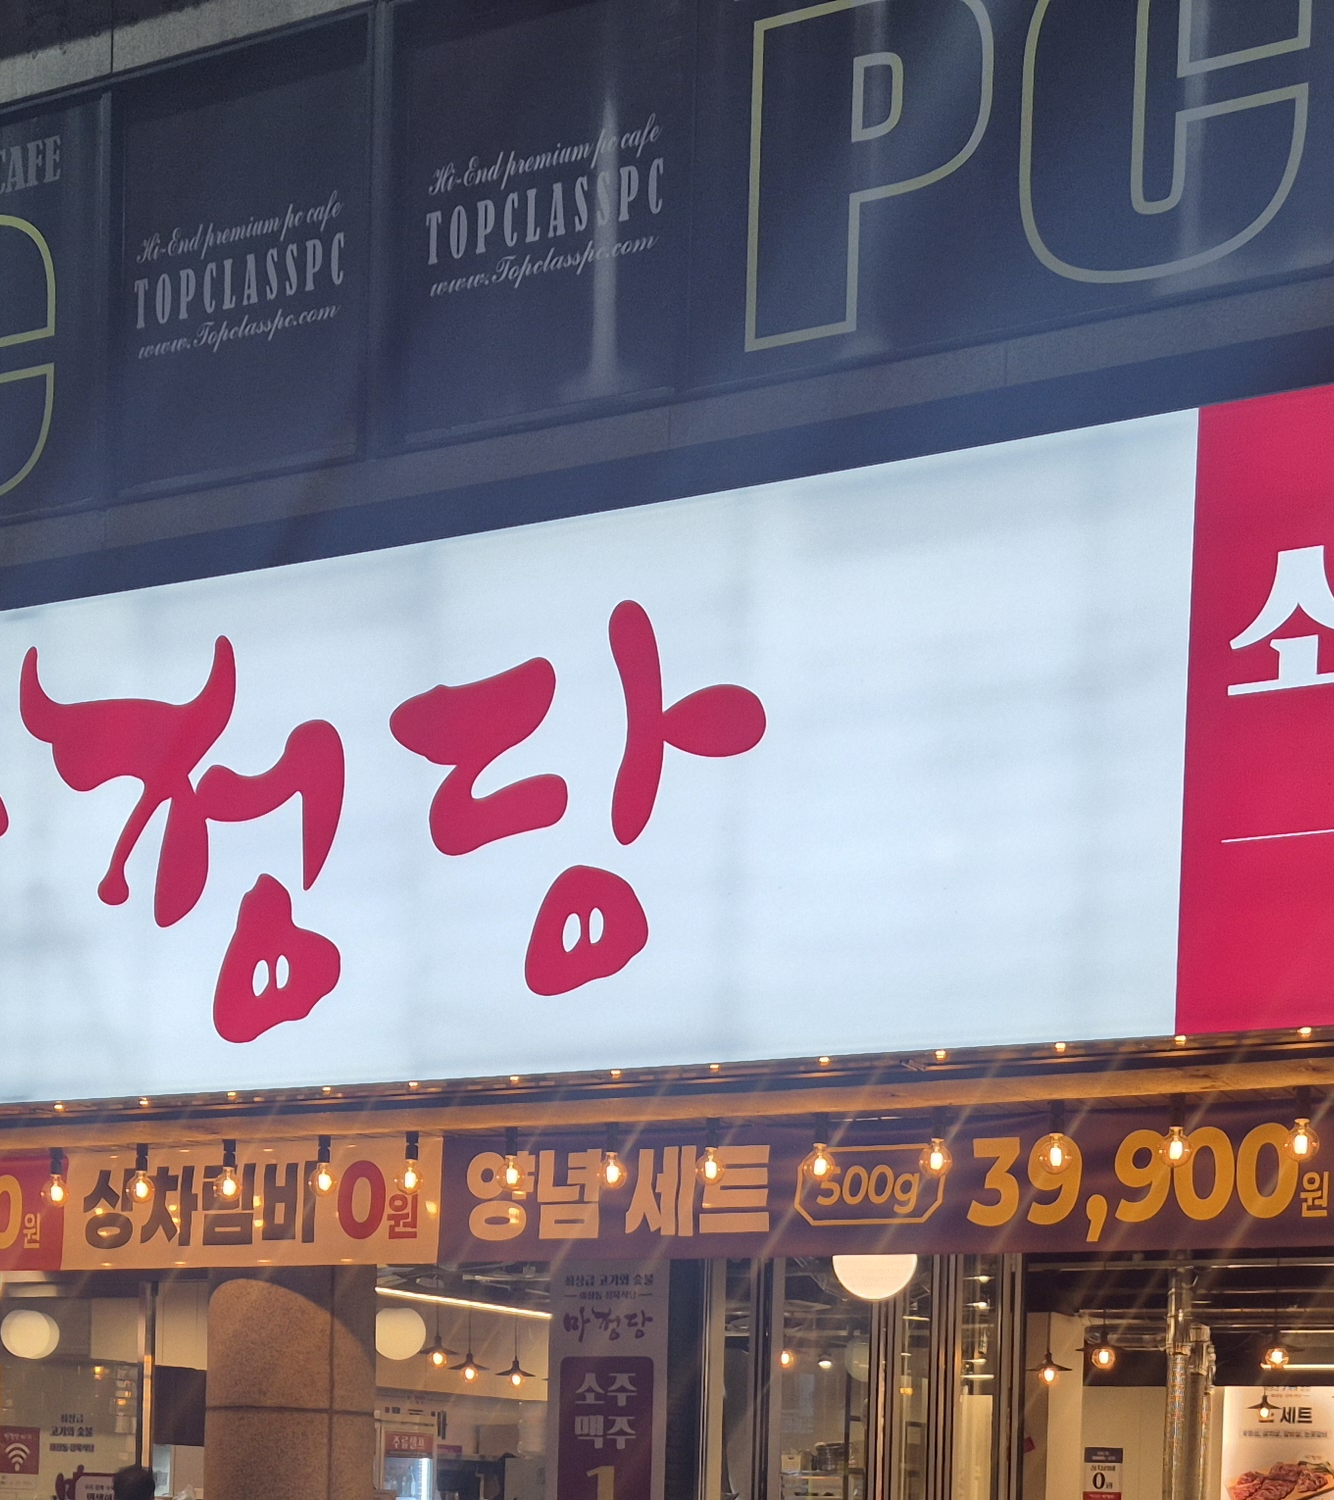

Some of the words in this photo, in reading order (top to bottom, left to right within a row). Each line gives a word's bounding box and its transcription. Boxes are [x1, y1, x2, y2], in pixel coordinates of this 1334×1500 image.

[745, 0, 1310, 352] PC
[425, 157, 664, 265] TOPCLASSPC
[134, 232, 345, 329] TOPCLASSPC
[467, 1146, 602, 1242] 양념
[624, 1144, 770, 1237] 세트
[563, 1306, 654, 1343] 마정당
[575, 1373, 638, 1407] 소주
[1280, 1406, 1313, 1424] 세트
[575, 1414, 637, 1450] 맥주
